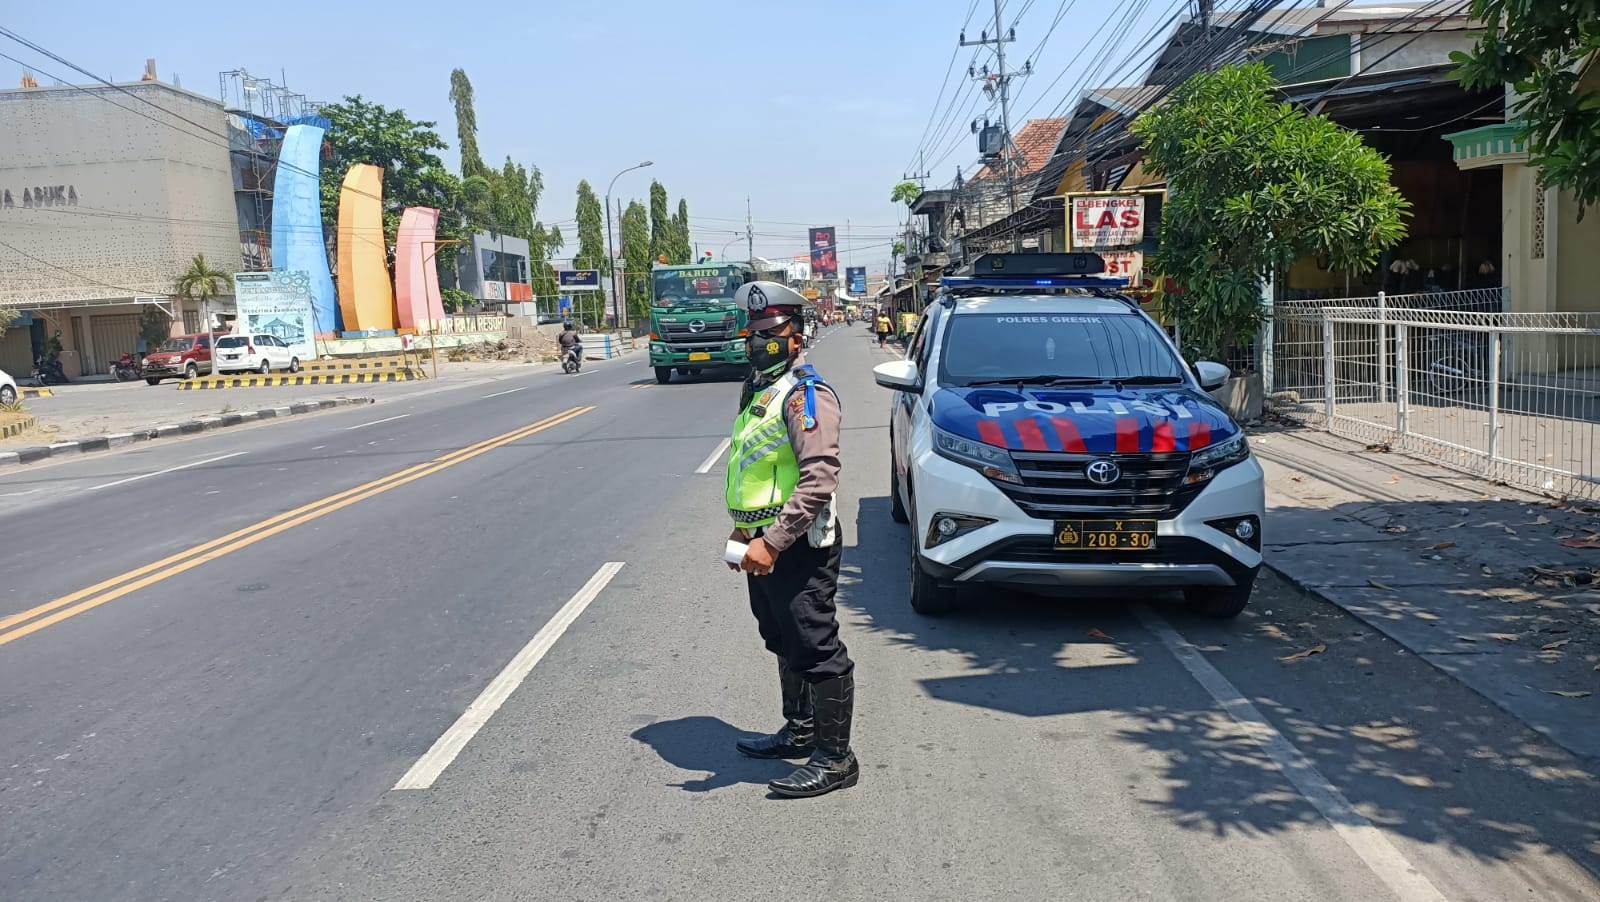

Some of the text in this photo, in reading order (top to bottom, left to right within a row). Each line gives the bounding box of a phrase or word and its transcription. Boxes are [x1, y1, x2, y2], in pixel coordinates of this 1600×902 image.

[1076, 210, 1140, 229] LAS
[982, 399, 1193, 418] POLISI
[1115, 521, 1123, 531] X
